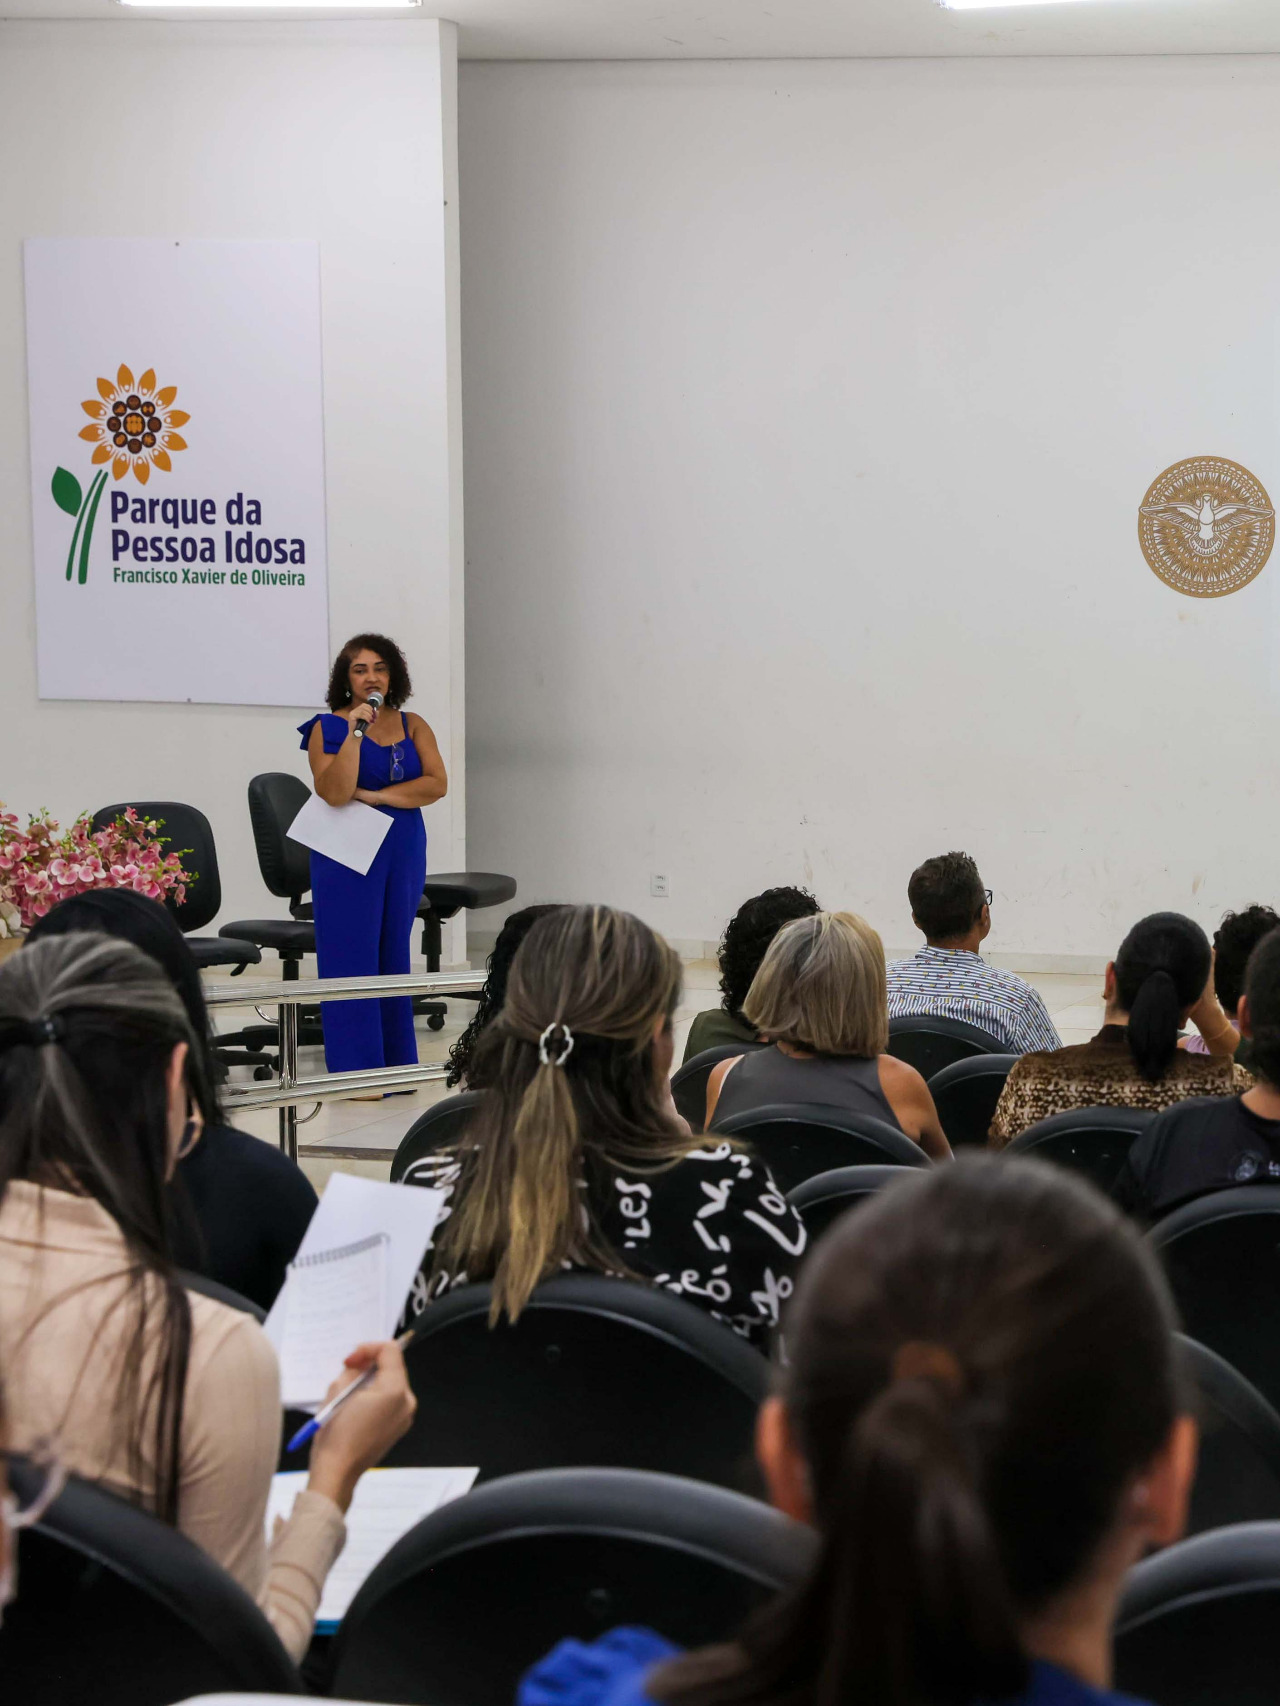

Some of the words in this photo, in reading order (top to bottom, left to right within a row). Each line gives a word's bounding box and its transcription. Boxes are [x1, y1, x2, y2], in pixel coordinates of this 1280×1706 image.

[110, 490, 217, 529] Parque
[225, 492, 262, 526] da
[111, 528, 216, 564] Pessoa
[224, 530, 306, 565] Idosa
[113, 566, 178, 585] Francisco
[181, 567, 227, 585] Xavier
[229, 568, 248, 586] de
[251, 568, 306, 586] Oliveira
